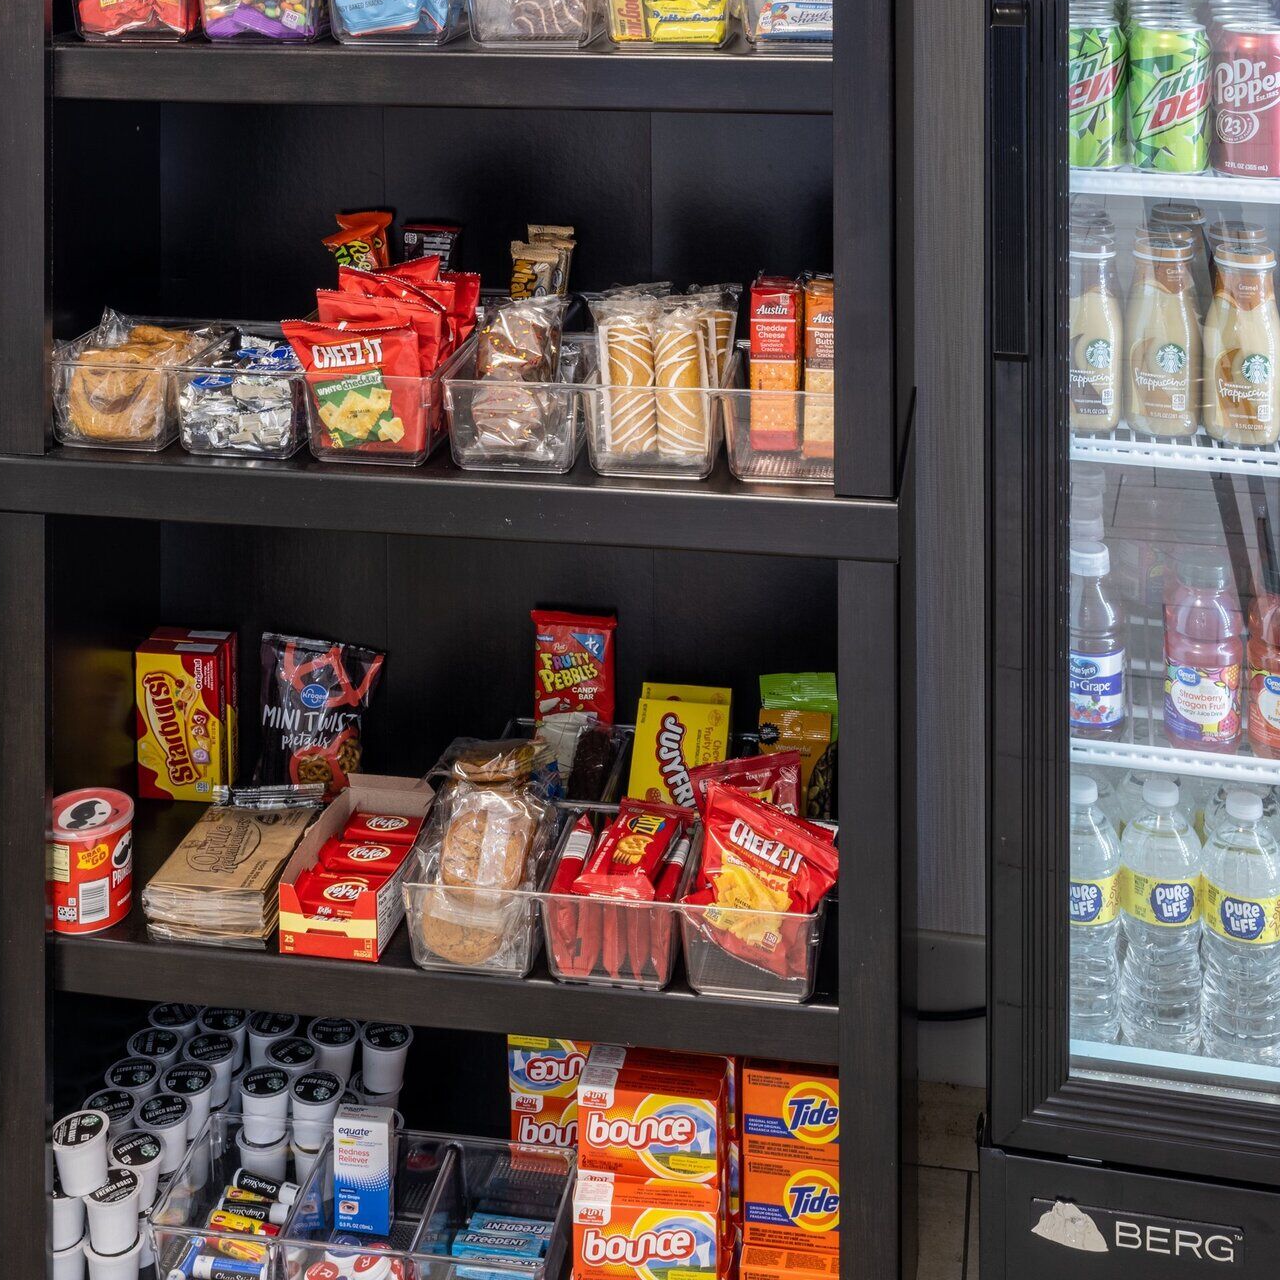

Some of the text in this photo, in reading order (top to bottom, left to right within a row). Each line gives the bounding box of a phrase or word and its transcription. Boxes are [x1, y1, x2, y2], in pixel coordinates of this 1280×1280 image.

[349, 0, 383, 11] BAKED SNACKS
[1232, 58, 1267, 80] Dr
[1224, 116, 1241, 136] 23
[757, 304, 788, 315] Austin
[312, 338, 383, 369] CHEEZ-IT
[317, 372, 382, 398] WHITE cheddar
[584, 637, 600, 654] XL
[540, 652, 590, 670] FRUITY
[195, 658, 203, 690] Original
[539, 662, 598, 694] PEBBLES
[302, 689, 328, 703] Kroger
[578, 692, 594, 700] BAR
[1177, 697, 1206, 711] Dragon
[1179, 688, 1223, 704] Strawberry
[262, 704, 358, 732] MINI TWIST
[143, 673, 197, 785] Starburst
[282, 732, 331, 751] pretzels
[81, 847, 102, 861] GRAB
[285, 935, 294, 943] 25
[788, 1097, 839, 1131] Tide
[338, 1127, 369, 1137] equate
[589, 1112, 691, 1148] bounce
[339, 1148, 370, 1157] Redness
[339, 1155, 368, 1164] Reliever
[95, 1178, 133, 1198] FRENCH ROAST
[789, 1186, 839, 1218] Tide
[586, 1229, 690, 1262] bounce
[1115, 1221, 1235, 1262] BERG
